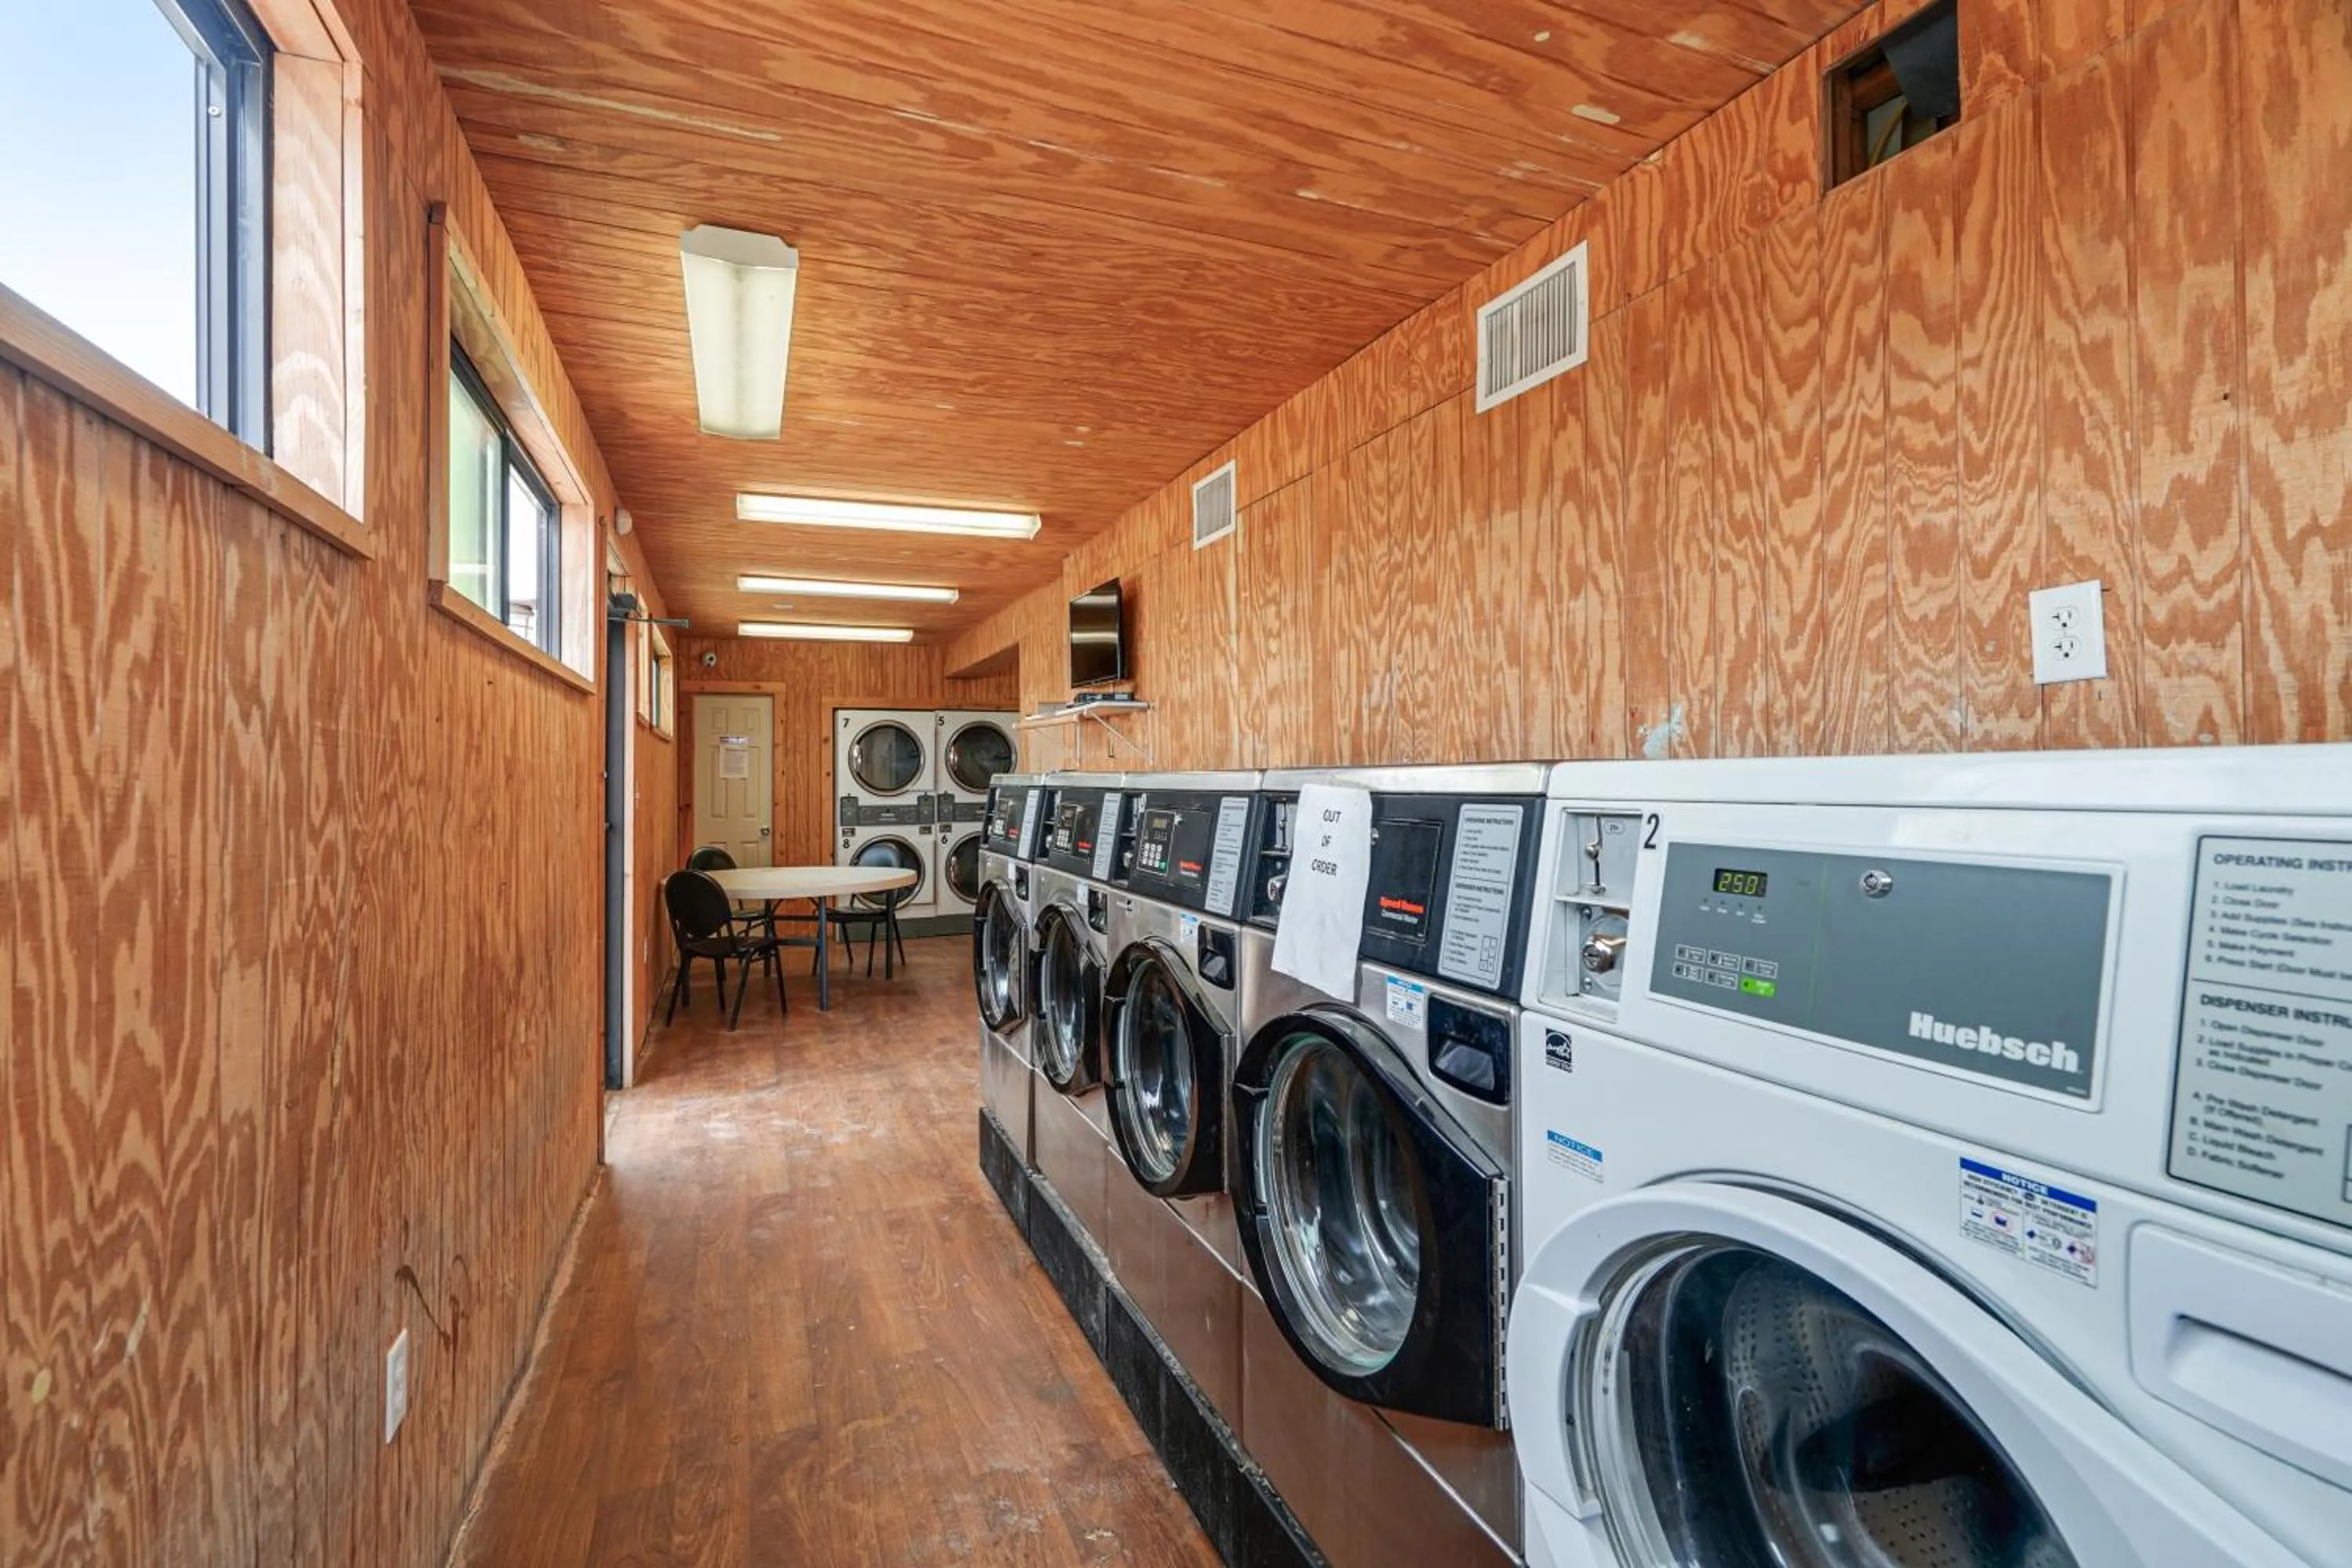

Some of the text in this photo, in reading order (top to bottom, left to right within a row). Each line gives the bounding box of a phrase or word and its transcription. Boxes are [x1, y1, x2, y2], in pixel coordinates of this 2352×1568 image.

[843, 717, 851, 728] 7
[938, 716, 945, 727] 5
[1323, 808, 1342, 823] OUT
[941, 835, 948, 844] 6
[1643, 813, 1660, 849] 2
[843, 839, 850, 849] 8
[1321, 834, 1332, 848] OF
[1312, 858, 1337, 877] ORDER
[2213, 853, 2303, 869] OPERATING
[1719, 873, 1758, 895] 250
[2224, 881, 2249, 891] Load
[2252, 883, 2295, 898] Laundry
[2223, 895, 2251, 907] Close
[2254, 898, 2279, 909] Door
[2249, 944, 2296, 958] Payment
[2200, 993, 2289, 1018] DISPENSER
[1908, 1011, 2079, 1073] Huebsch
[2241, 1024, 2293, 1043] Dispenser
[2296, 1034, 2325, 1048] Door
[2207, 1060, 2236, 1074] Close
[2238, 1065, 2291, 1087] Dispenser
[2294, 1076, 2323, 1091] Door
[1555, 1134, 1595, 1158] NOTICE
[2002, 1172, 2049, 1196] NOTICE
